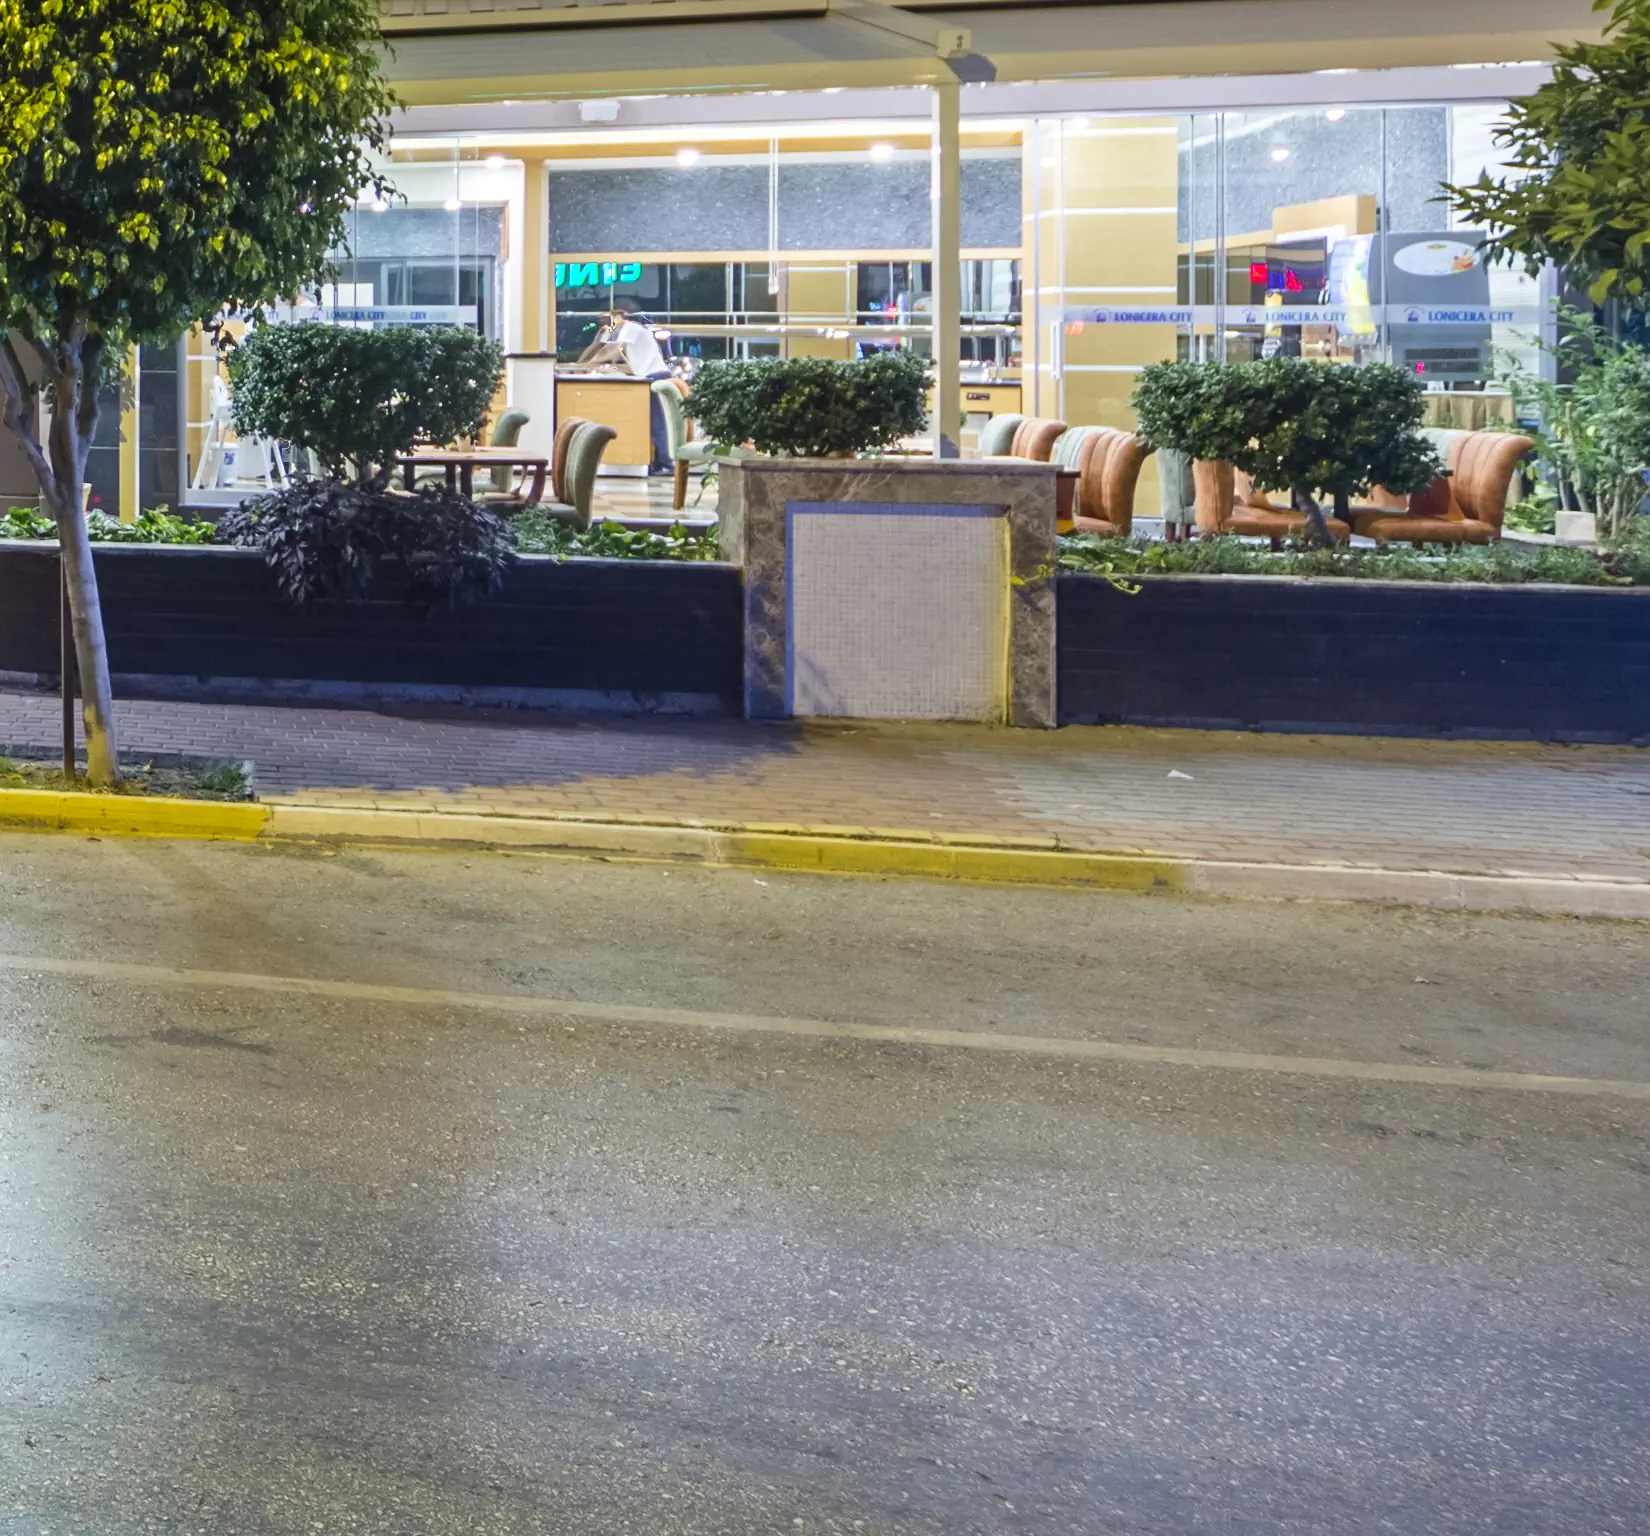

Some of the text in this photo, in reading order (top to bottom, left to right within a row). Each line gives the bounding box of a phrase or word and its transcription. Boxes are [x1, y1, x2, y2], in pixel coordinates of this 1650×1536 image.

[367, 311, 386, 320] CITY
[1114, 311, 1193, 322] LONICERA CITY
[1265, 311, 1347, 322] LONICERA CITY
[1428, 310, 1514, 322] LONICERA CITY
